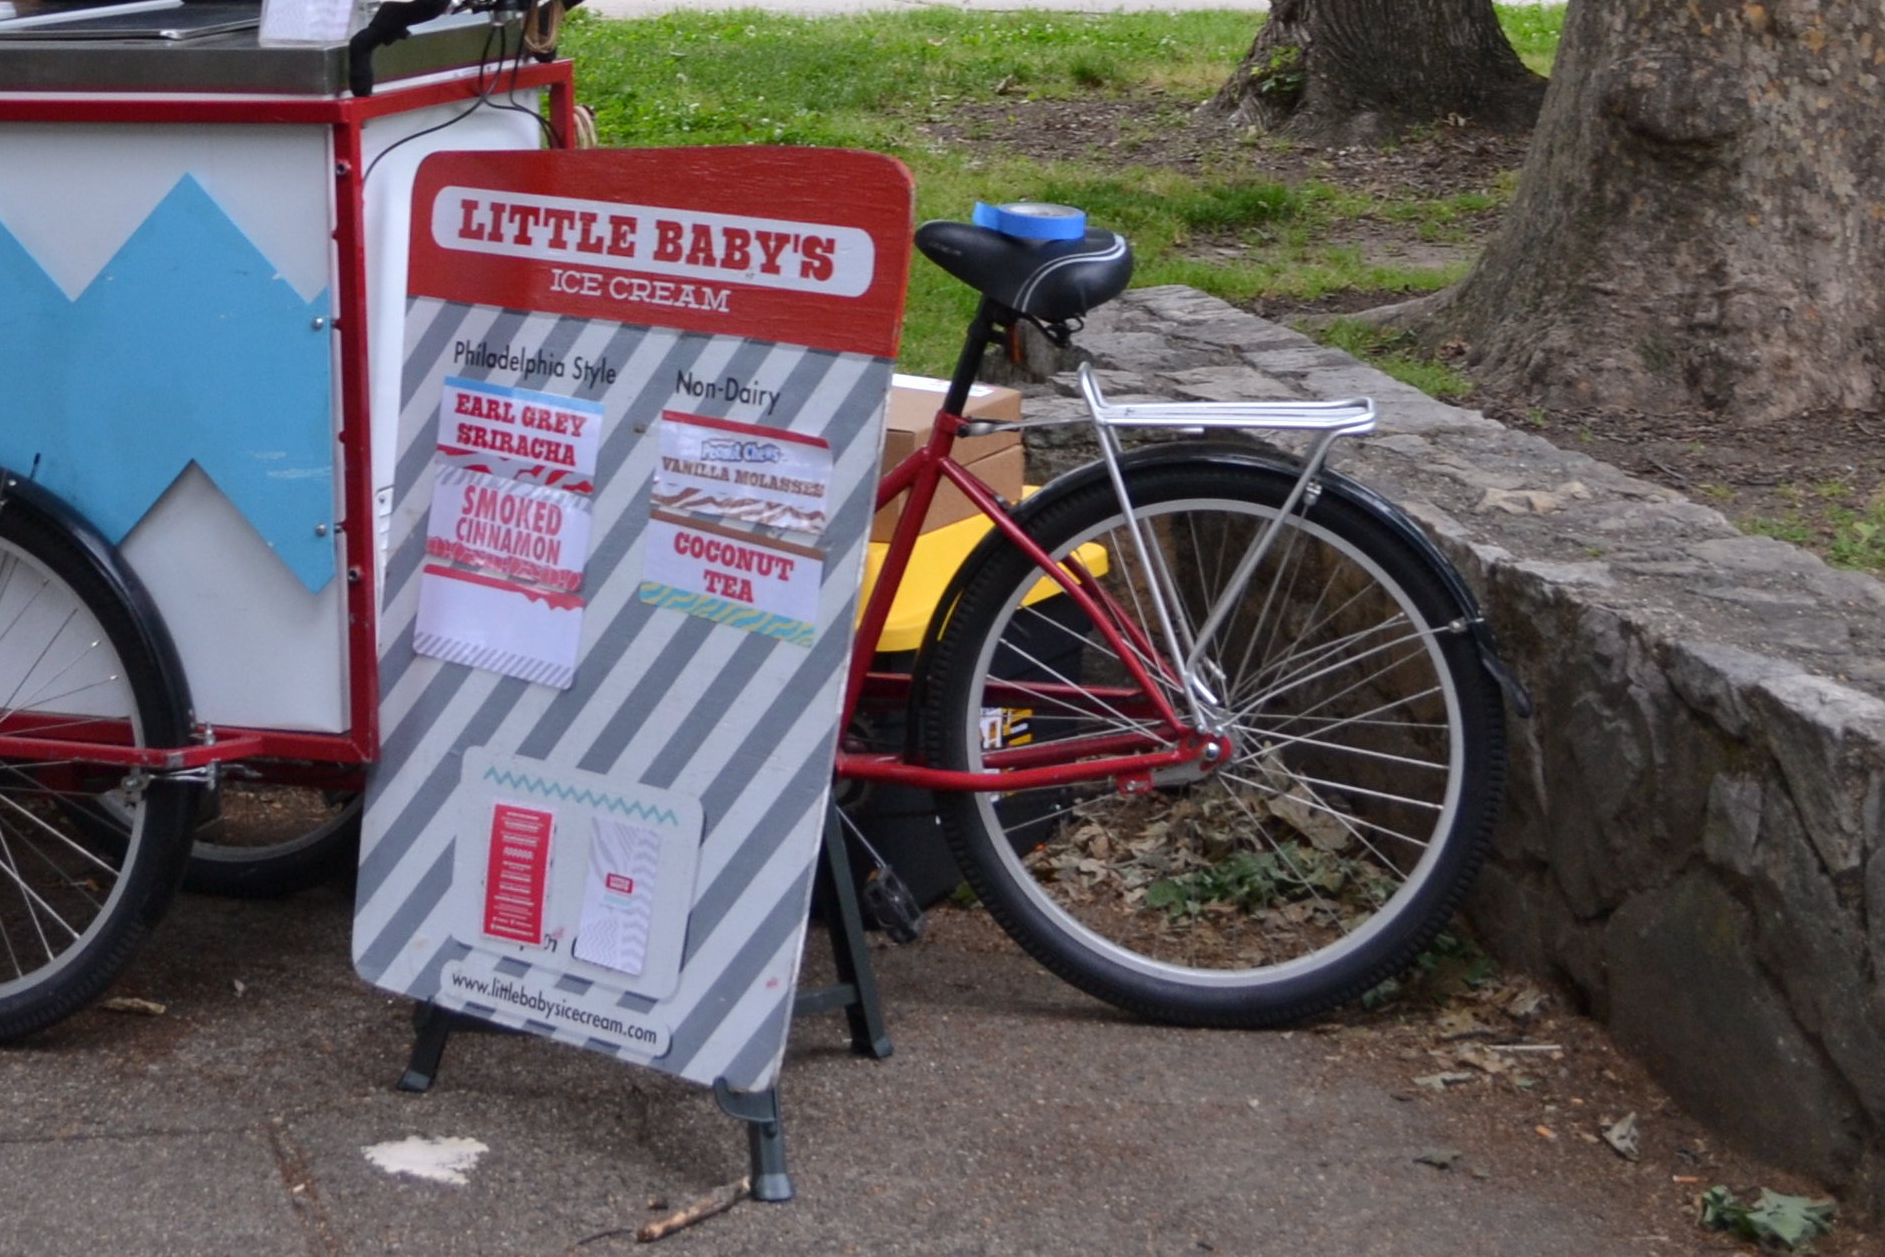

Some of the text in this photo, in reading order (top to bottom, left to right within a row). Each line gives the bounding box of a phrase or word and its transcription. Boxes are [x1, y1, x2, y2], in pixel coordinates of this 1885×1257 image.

[458, 199, 836, 282] LITTLE BABY'S
[549, 268, 731, 313] ICE CREAM
[453, 340, 617, 389] Philadelphia Style
[455, 393, 587, 437] EARL GREY
[676, 370, 781, 416] Non-Dairy
[456, 423, 577, 467] SRIRACHA
[661, 456, 825, 498] VANILLA MOLASSES
[462, 485, 563, 537] SMOKED
[455, 517, 562, 566] CINNAMON
[673, 531, 795, 581] COCONUT
[703, 569, 754, 603] TEA
[452, 972, 657, 1045] www.littlebabysicecream.com
